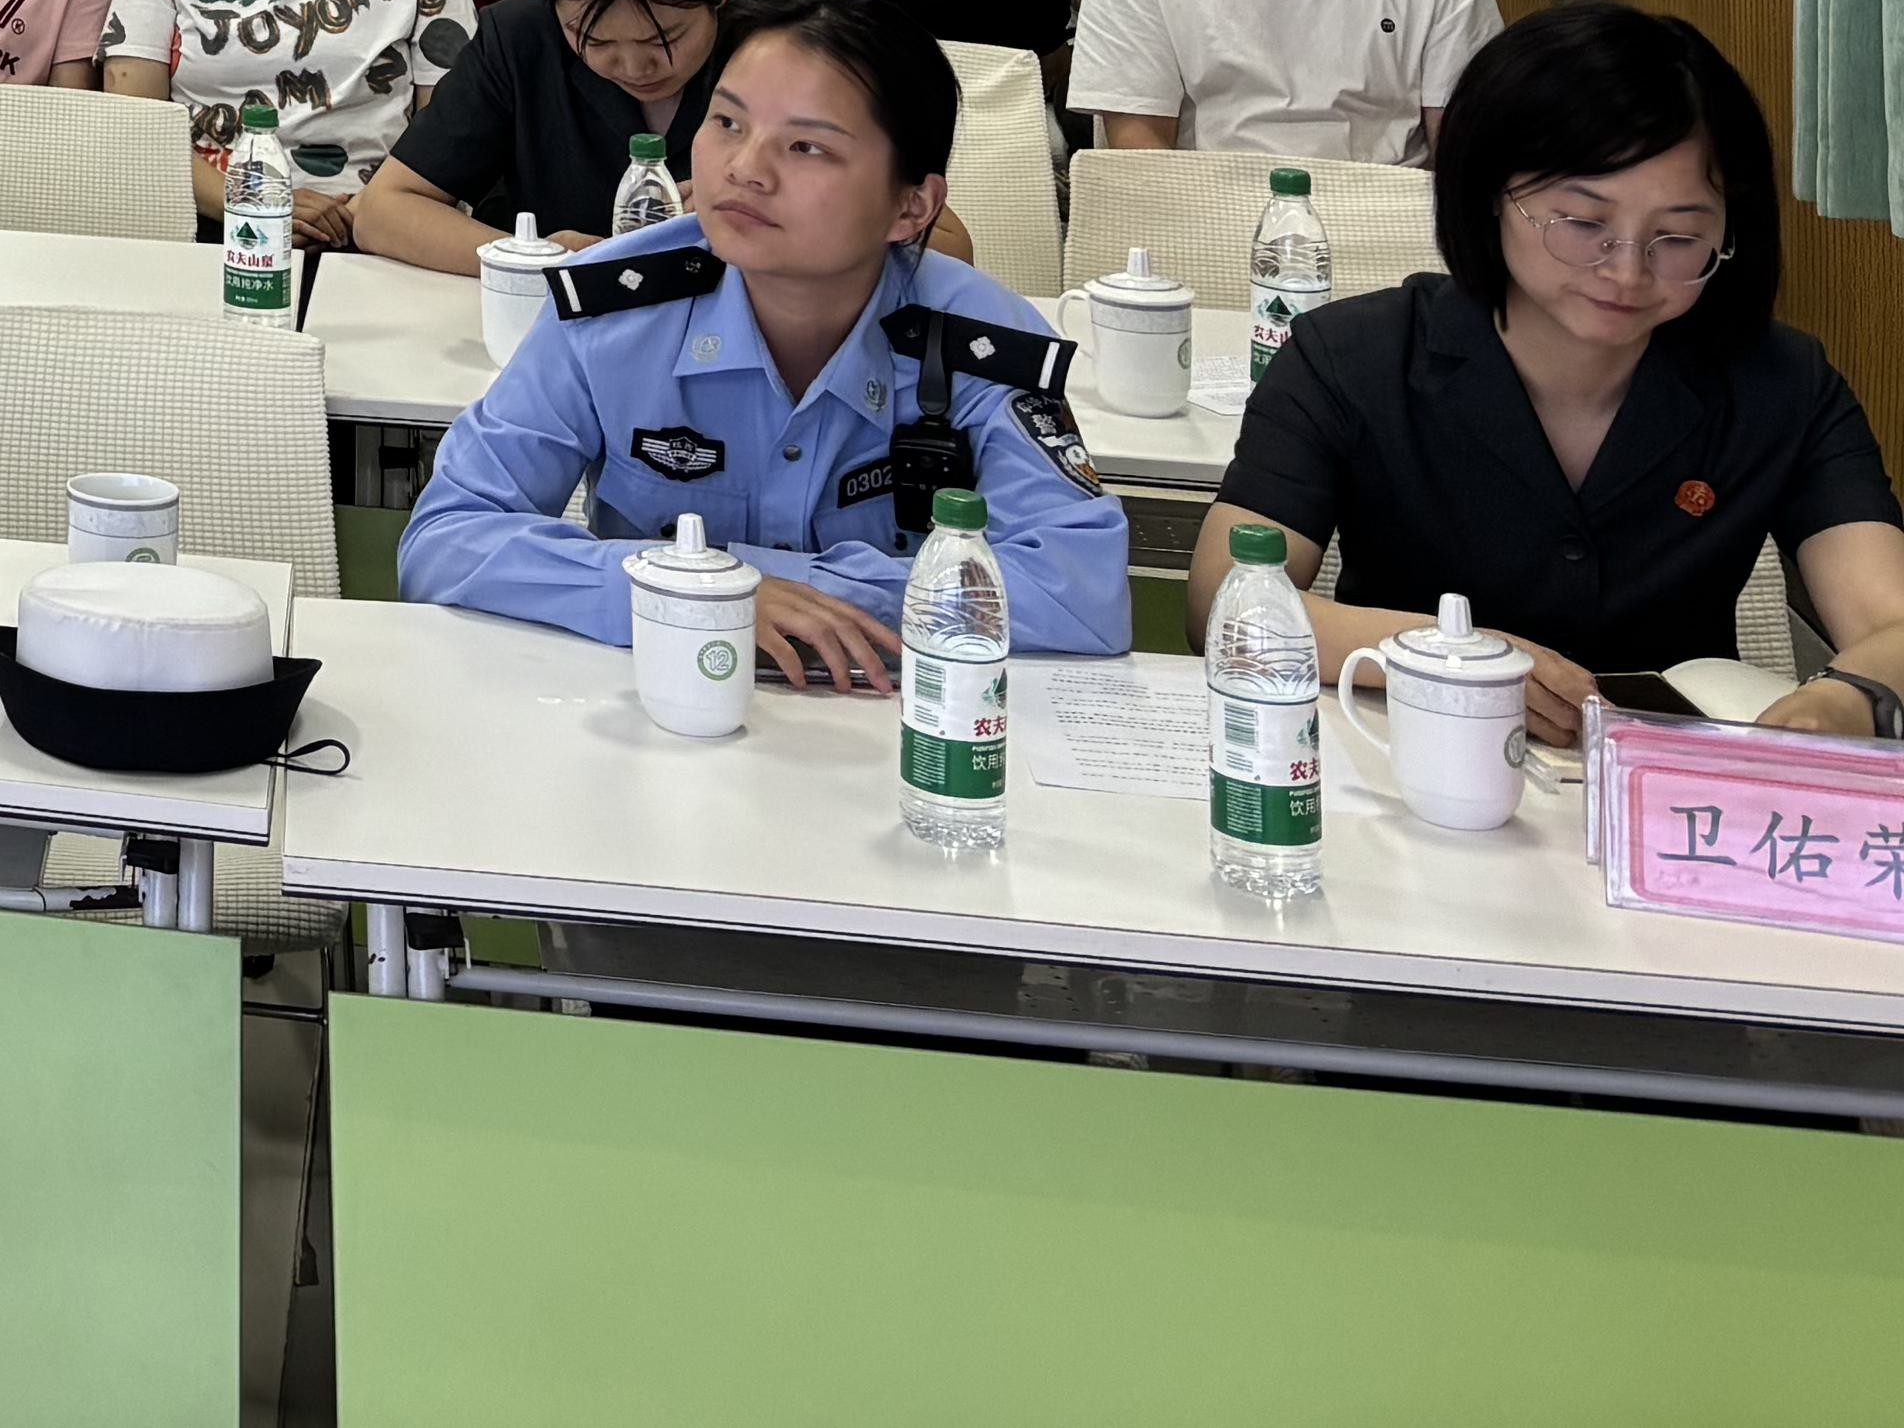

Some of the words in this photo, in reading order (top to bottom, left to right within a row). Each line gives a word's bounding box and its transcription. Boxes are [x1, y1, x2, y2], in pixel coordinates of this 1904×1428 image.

[1031, 413, 1058, 436] 警
[846, 464, 893, 496] 0302
[973, 716, 1007, 738] 农夫
[1289, 799, 1321, 818] 饮用
